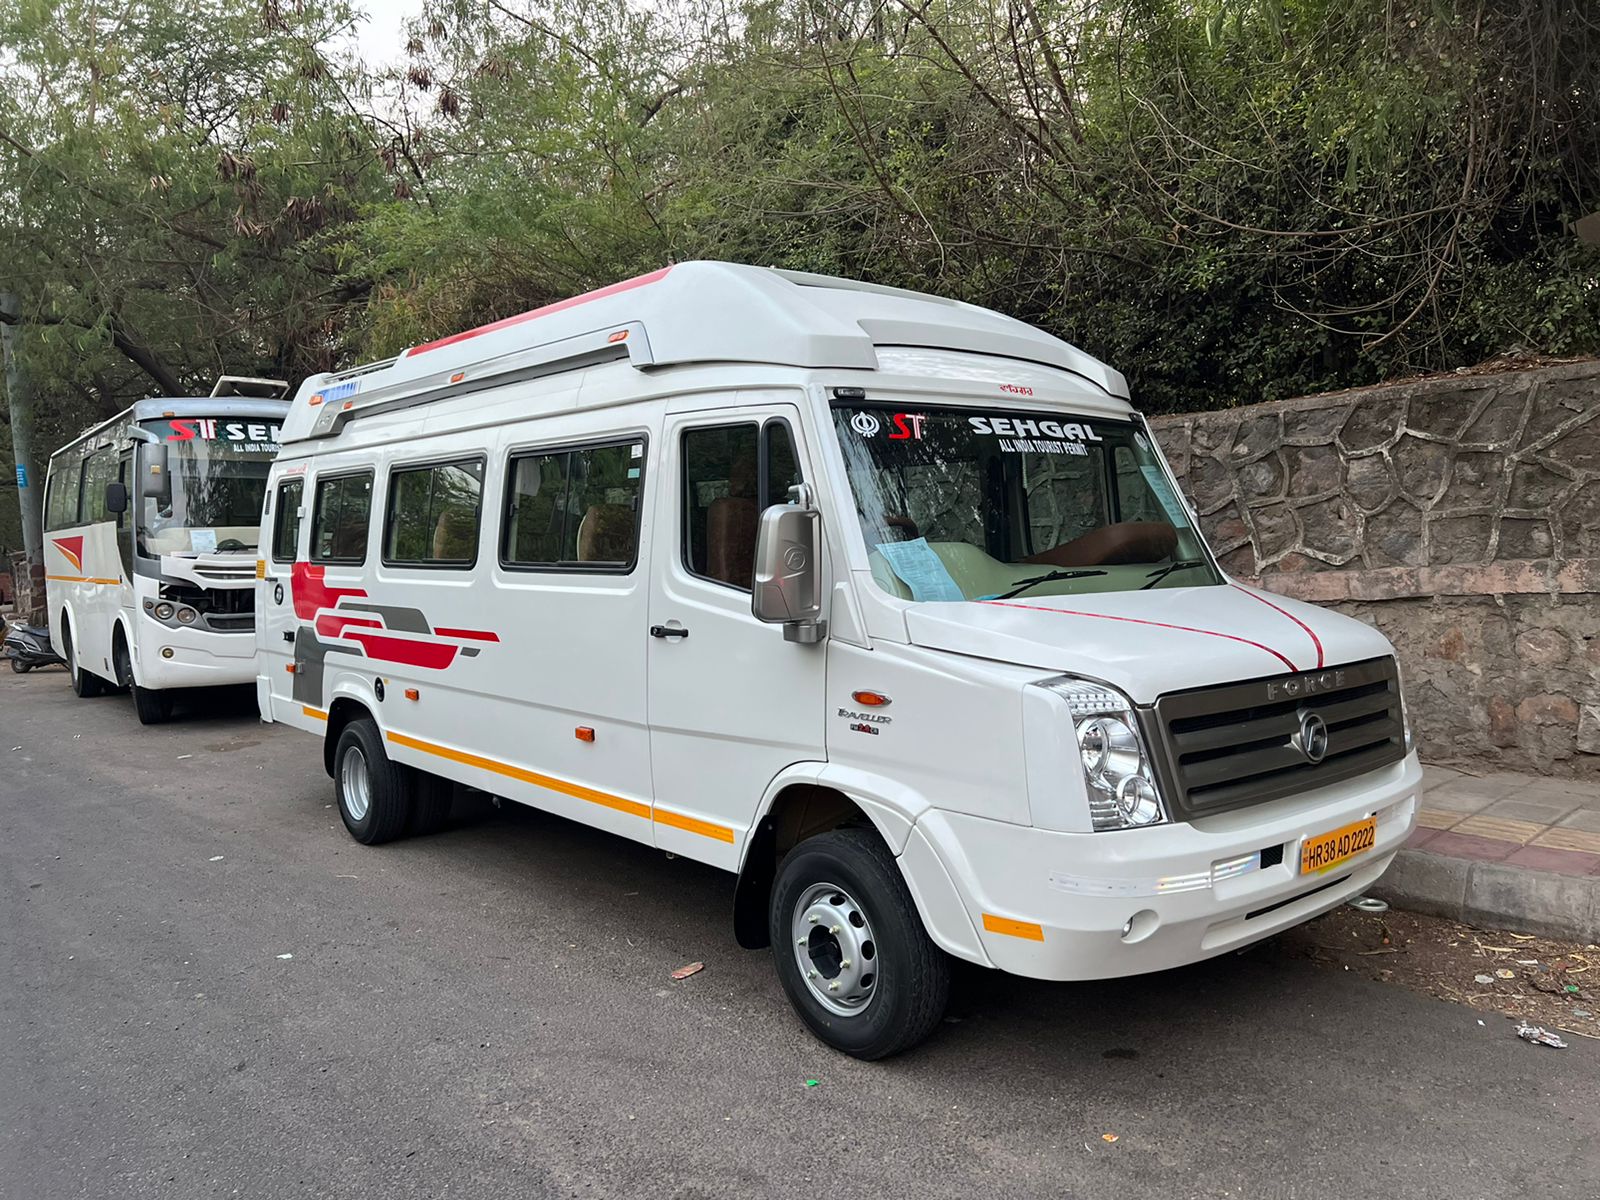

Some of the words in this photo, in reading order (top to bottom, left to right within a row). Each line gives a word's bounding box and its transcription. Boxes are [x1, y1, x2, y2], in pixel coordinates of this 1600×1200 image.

[888, 413, 925, 440] ST
[968, 416, 1103, 441] SEHGAL
[233, 443, 244, 452] ALL
[245, 443, 260, 453] INDIA
[998, 439, 1016, 452] ALL
[1012, 439, 1036, 453] INDIA
[1032, 439, 1065, 454] TOURIST
[1061, 442, 1089, 456] PERMIT
[1267, 671, 1345, 701] FORCE
[838, 708, 892, 725] TRAVELLER
[1351, 825, 1375, 853] 2222
